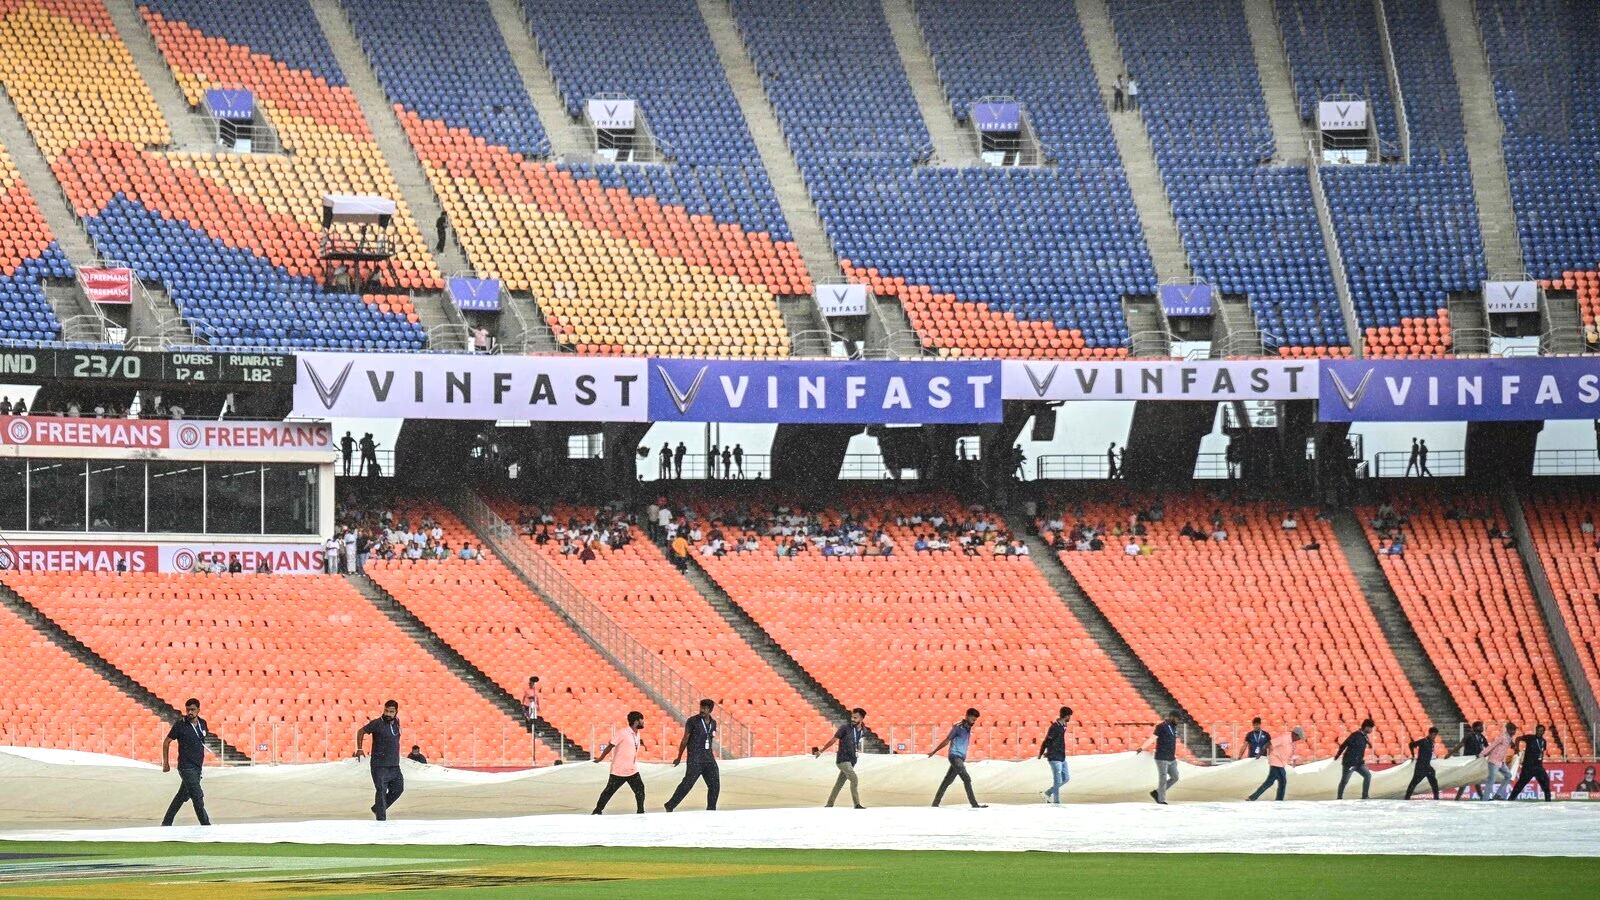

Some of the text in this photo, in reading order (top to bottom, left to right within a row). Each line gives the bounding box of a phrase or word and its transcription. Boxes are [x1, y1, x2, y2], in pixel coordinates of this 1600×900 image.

[209, 109, 252, 118] INFAST
[1163, 306, 1211, 314] VINFAST
[73, 355, 141, 378] 23/0
[172, 354, 214, 365] OVERS
[229, 355, 284, 367] RUNRATE
[243, 368, 272, 381] 1.82
[1074, 366, 1304, 394] VINFAST
[366, 370, 638, 406] VINFAST
[719, 374, 993, 409] VINFAST
[35, 422, 162, 446] FREEMANS
[204, 427, 328, 447] FREEMANS
[18, 550, 145, 572] FREEMANS
